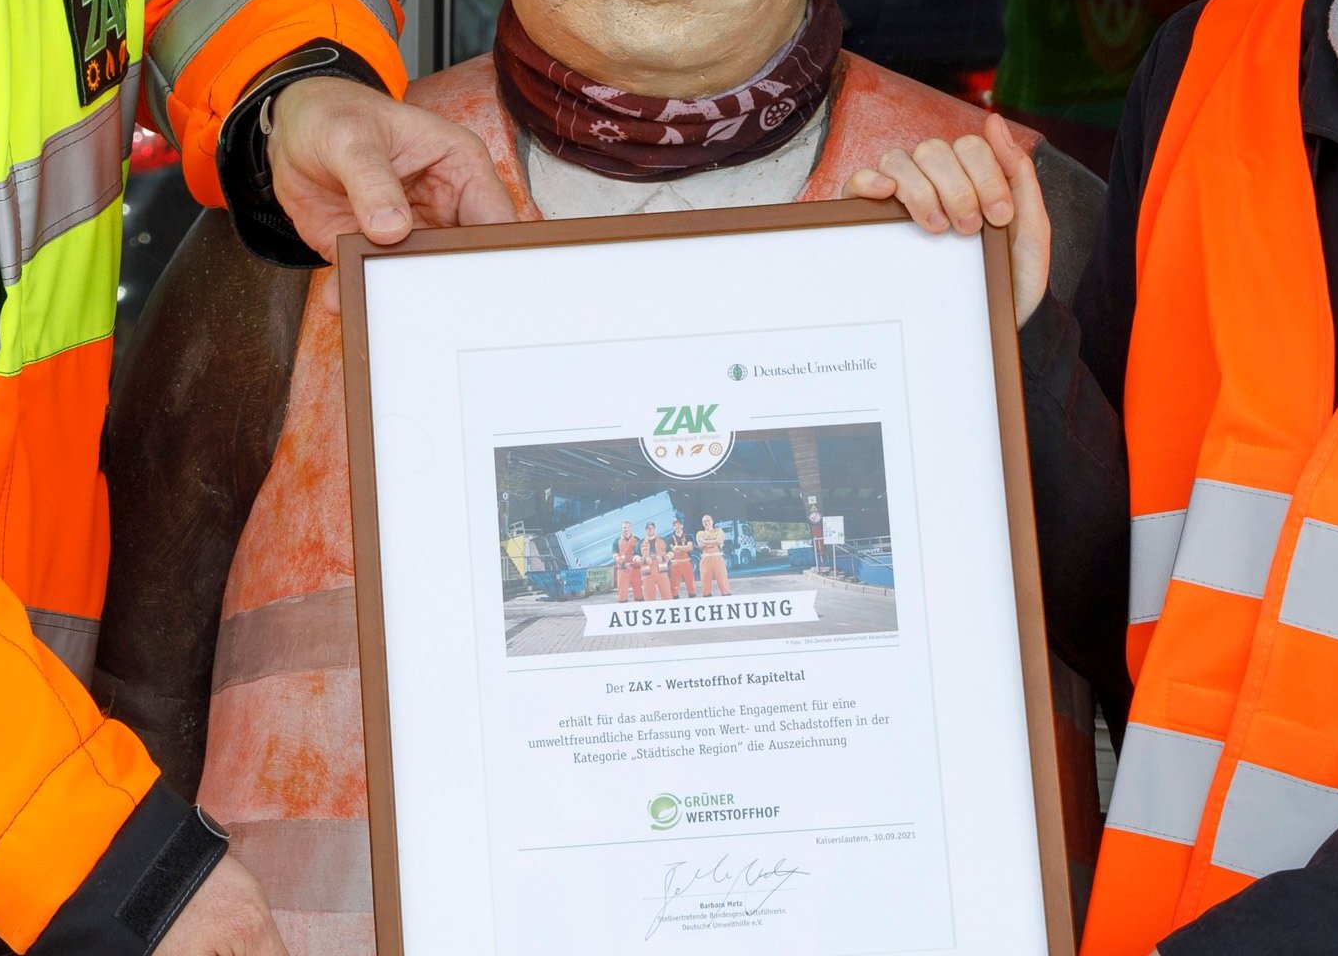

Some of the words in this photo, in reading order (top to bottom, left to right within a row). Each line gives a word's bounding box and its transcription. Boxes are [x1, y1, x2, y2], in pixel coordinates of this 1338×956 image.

[653, 404, 719, 436] ZAK
[608, 599, 793, 628] AUSZEICHNUNG
[605, 682, 625, 694] Der
[628, 679, 654, 693] ZAK
[664, 674, 743, 691] Wertstoffhof
[746, 670, 806, 687] Kapiteltal
[558, 714, 594, 728] erhält
[597, 714, 614, 726] für
[617, 713, 636, 725] das
[640, 705, 737, 724] außerordentliche
[739, 702, 808, 719] Engagement
[812, 700, 829, 712] für
[832, 698, 857, 710] eine
[528, 730, 634, 750] umweltfreundliche
[637, 726, 692, 743] Erfassung
[694, 727, 717, 738] von
[719, 724, 751, 737] Wert-
[754, 720, 777, 733] und
[779, 716, 854, 733] Schadstoffen
[856, 715, 869, 726] in
[871, 713, 890, 726] der
[572, 748, 628, 764] Kategorie
[631, 744, 696, 762] „Städtische
[698, 741, 743, 757] Region“
[747, 740, 765, 752] die
[768, 734, 848, 751] Auszeichnung
[684, 792, 735, 808] GRÜNER
[685, 805, 781, 824] WERTSTOFFHOF
[815, 833, 871, 845] Kaiserslautern,
[873, 830, 917, 842] 30.09.2021
[699, 901, 725, 910] Barbara
[727, 900, 743, 908] Metz
[682, 922, 711, 932] Deutsche
[712, 920, 751, 930] Umwelthilfe
